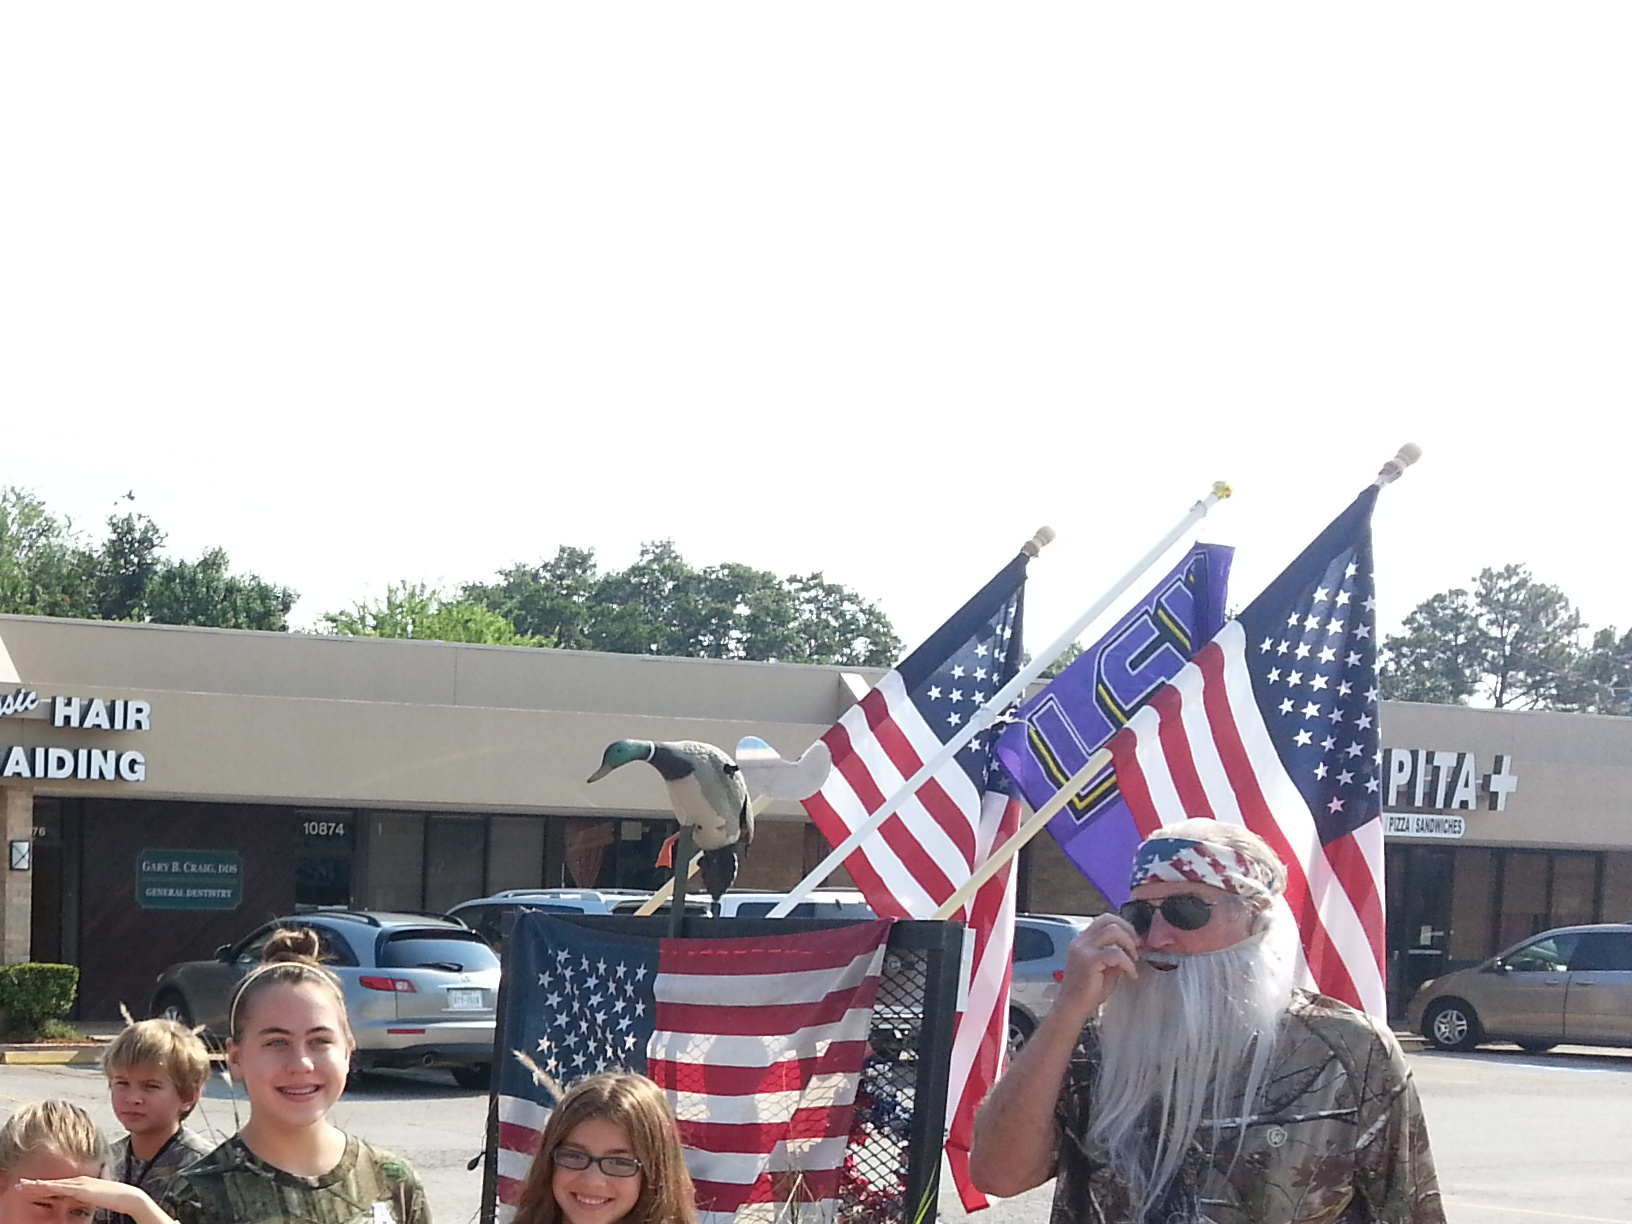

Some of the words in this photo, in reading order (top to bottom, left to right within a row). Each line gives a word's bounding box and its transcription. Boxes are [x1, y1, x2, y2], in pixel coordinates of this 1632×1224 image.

[52, 695, 152, 731] HAIR
[303, 821, 345, 836] 10874
[1415, 817, 1462, 835] SANDWICHES
[145, 887, 184, 898] GENERAL
[186, 889, 233, 899] DENTISTRY
